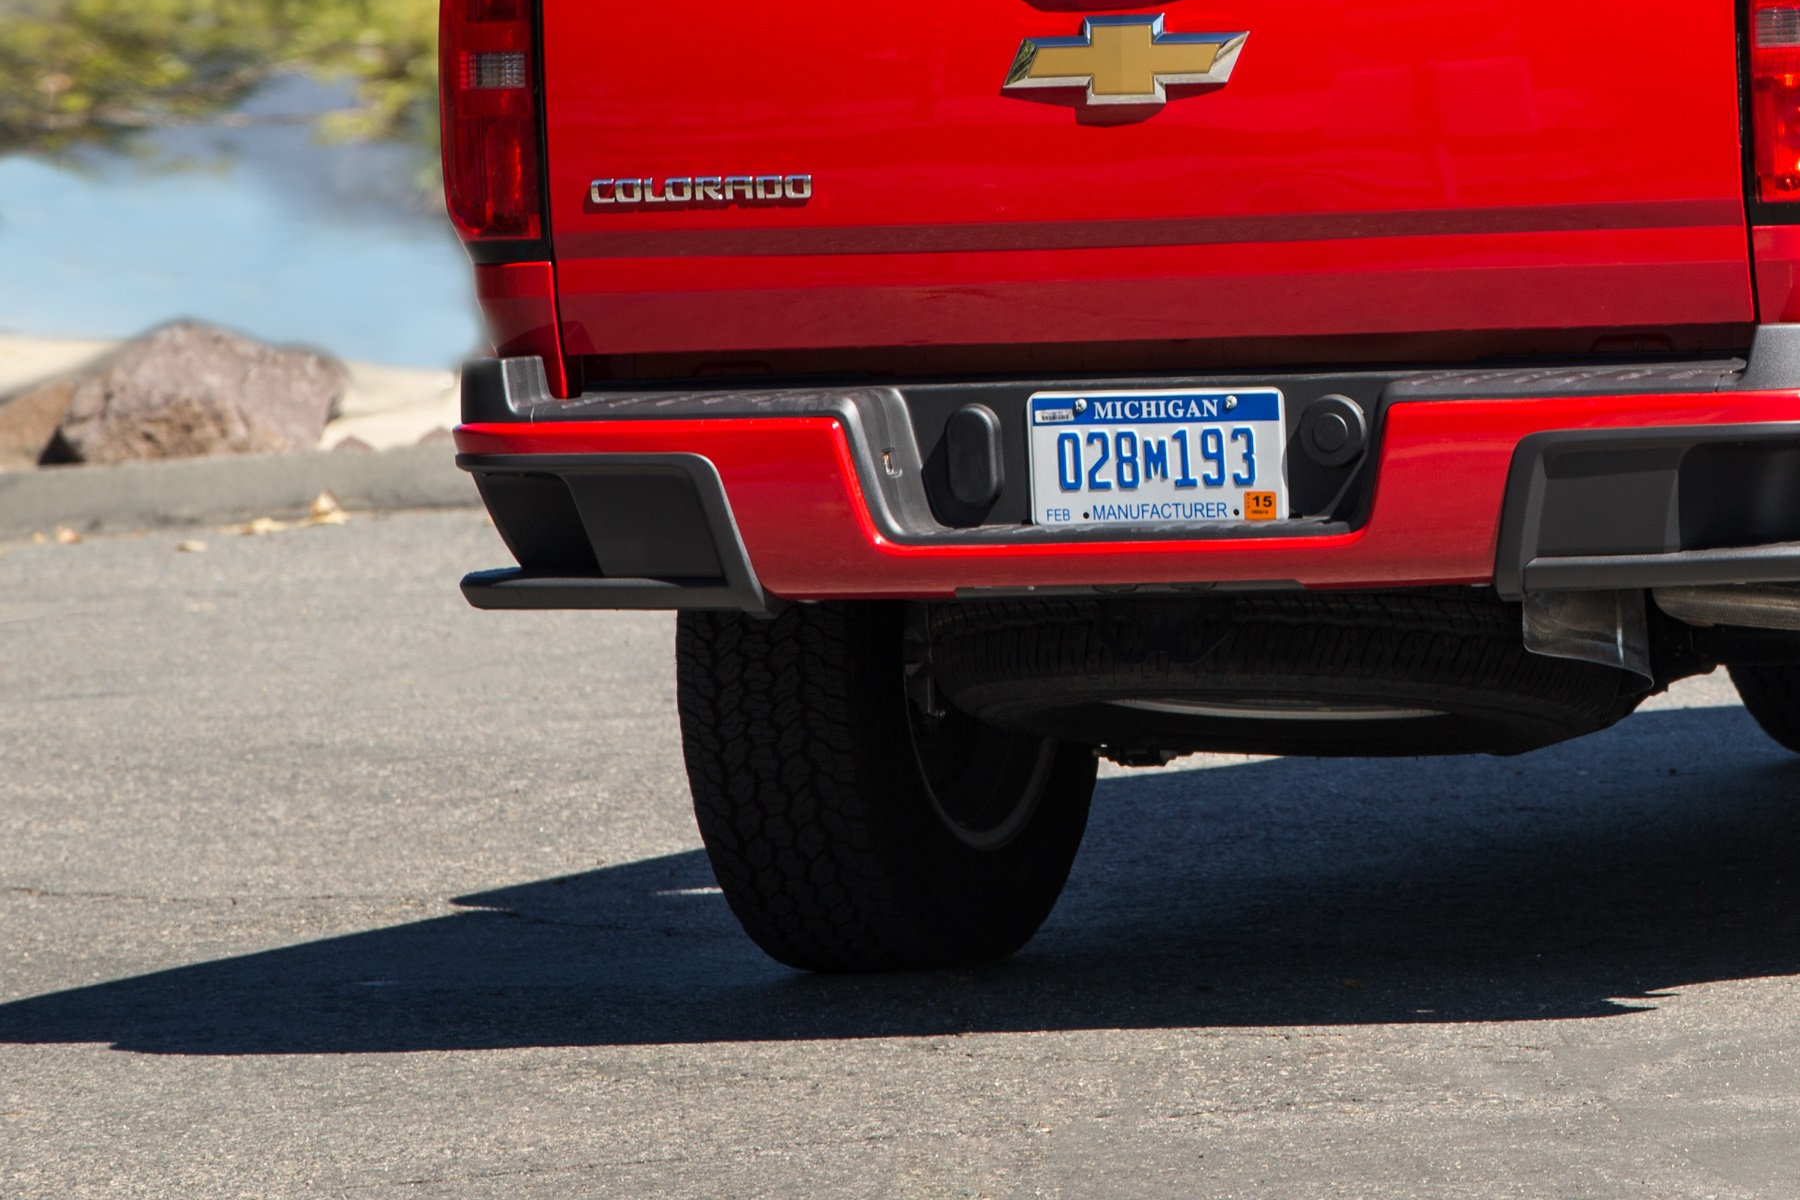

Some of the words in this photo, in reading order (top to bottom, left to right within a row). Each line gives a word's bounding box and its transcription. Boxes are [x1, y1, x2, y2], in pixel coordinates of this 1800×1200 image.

[590, 174, 812, 204] COLORADO
[1093, 400, 1218, 420] MICHIGAN
[1058, 426, 1256, 490] 028M193
[1252, 495, 1272, 508] 15
[1046, 508, 1071, 522] FEB
[1093, 502, 1228, 521] MANUFACTURER
